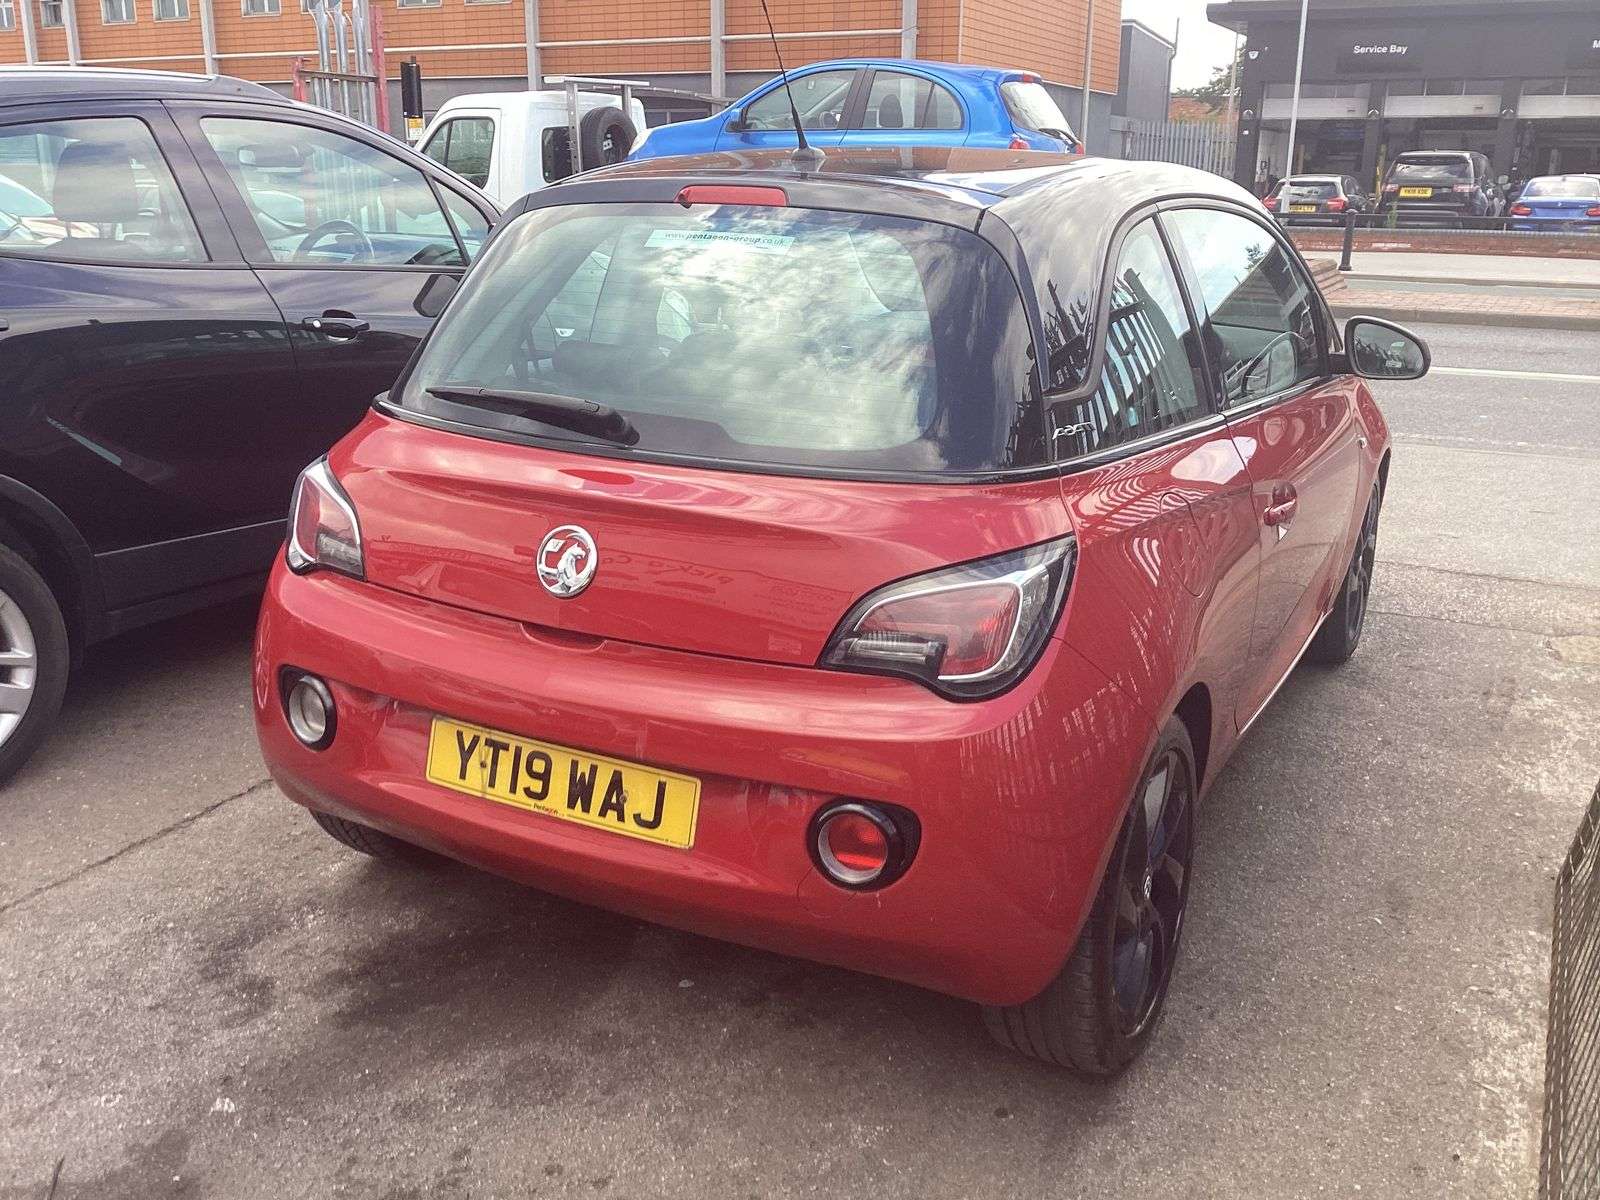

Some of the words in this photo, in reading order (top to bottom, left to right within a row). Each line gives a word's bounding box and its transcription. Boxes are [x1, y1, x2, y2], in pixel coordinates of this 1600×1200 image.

[1353, 45, 1388, 54] Service
[1390, 44, 1408, 55] Bay
[456, 729, 553, 801] YT19
[566, 759, 667, 830] WAJ
